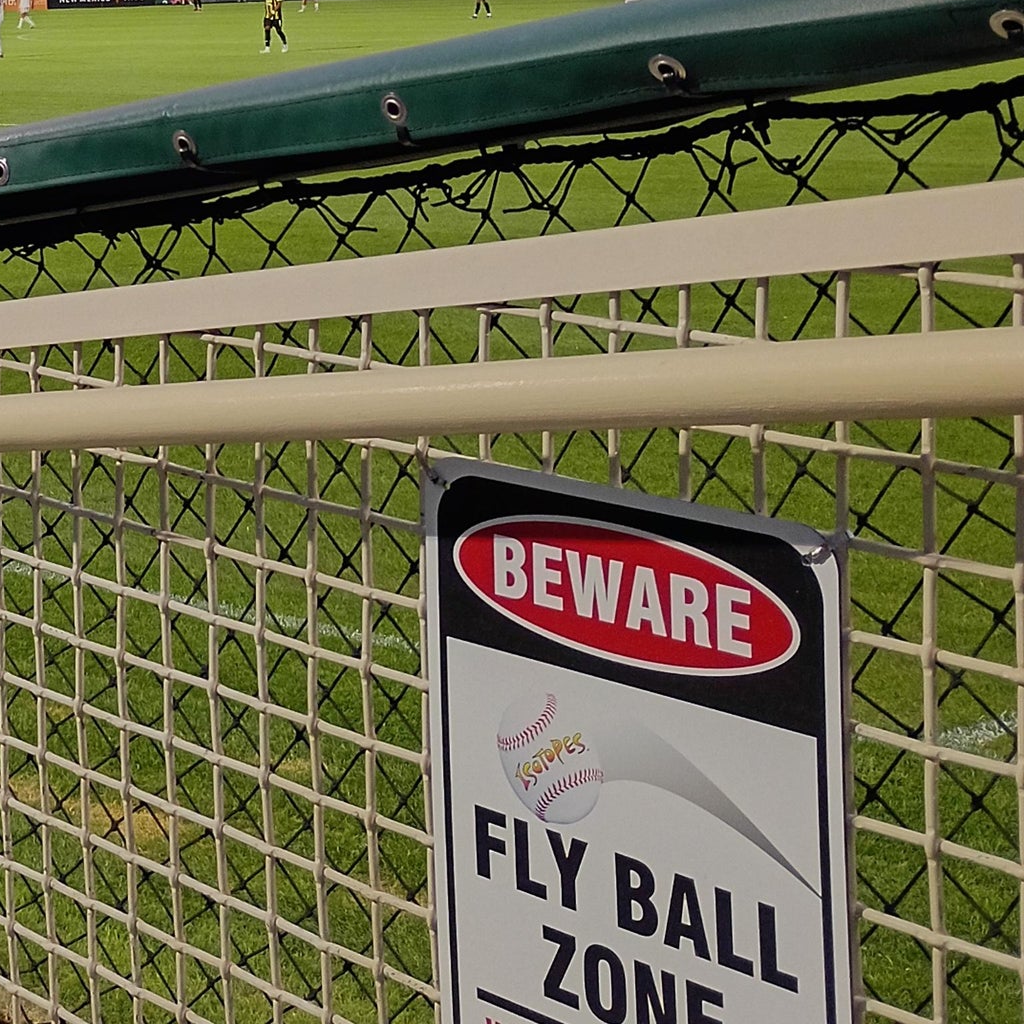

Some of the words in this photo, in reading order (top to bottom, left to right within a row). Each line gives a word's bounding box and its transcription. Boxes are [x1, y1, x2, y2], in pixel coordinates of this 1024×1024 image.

[492, 534, 753, 658] BEWARE
[514, 732, 586, 791] ISOTOPES
[474, 804, 589, 912] FLY
[613, 852, 799, 994] BALL
[542, 924, 724, 1024] ZONE
